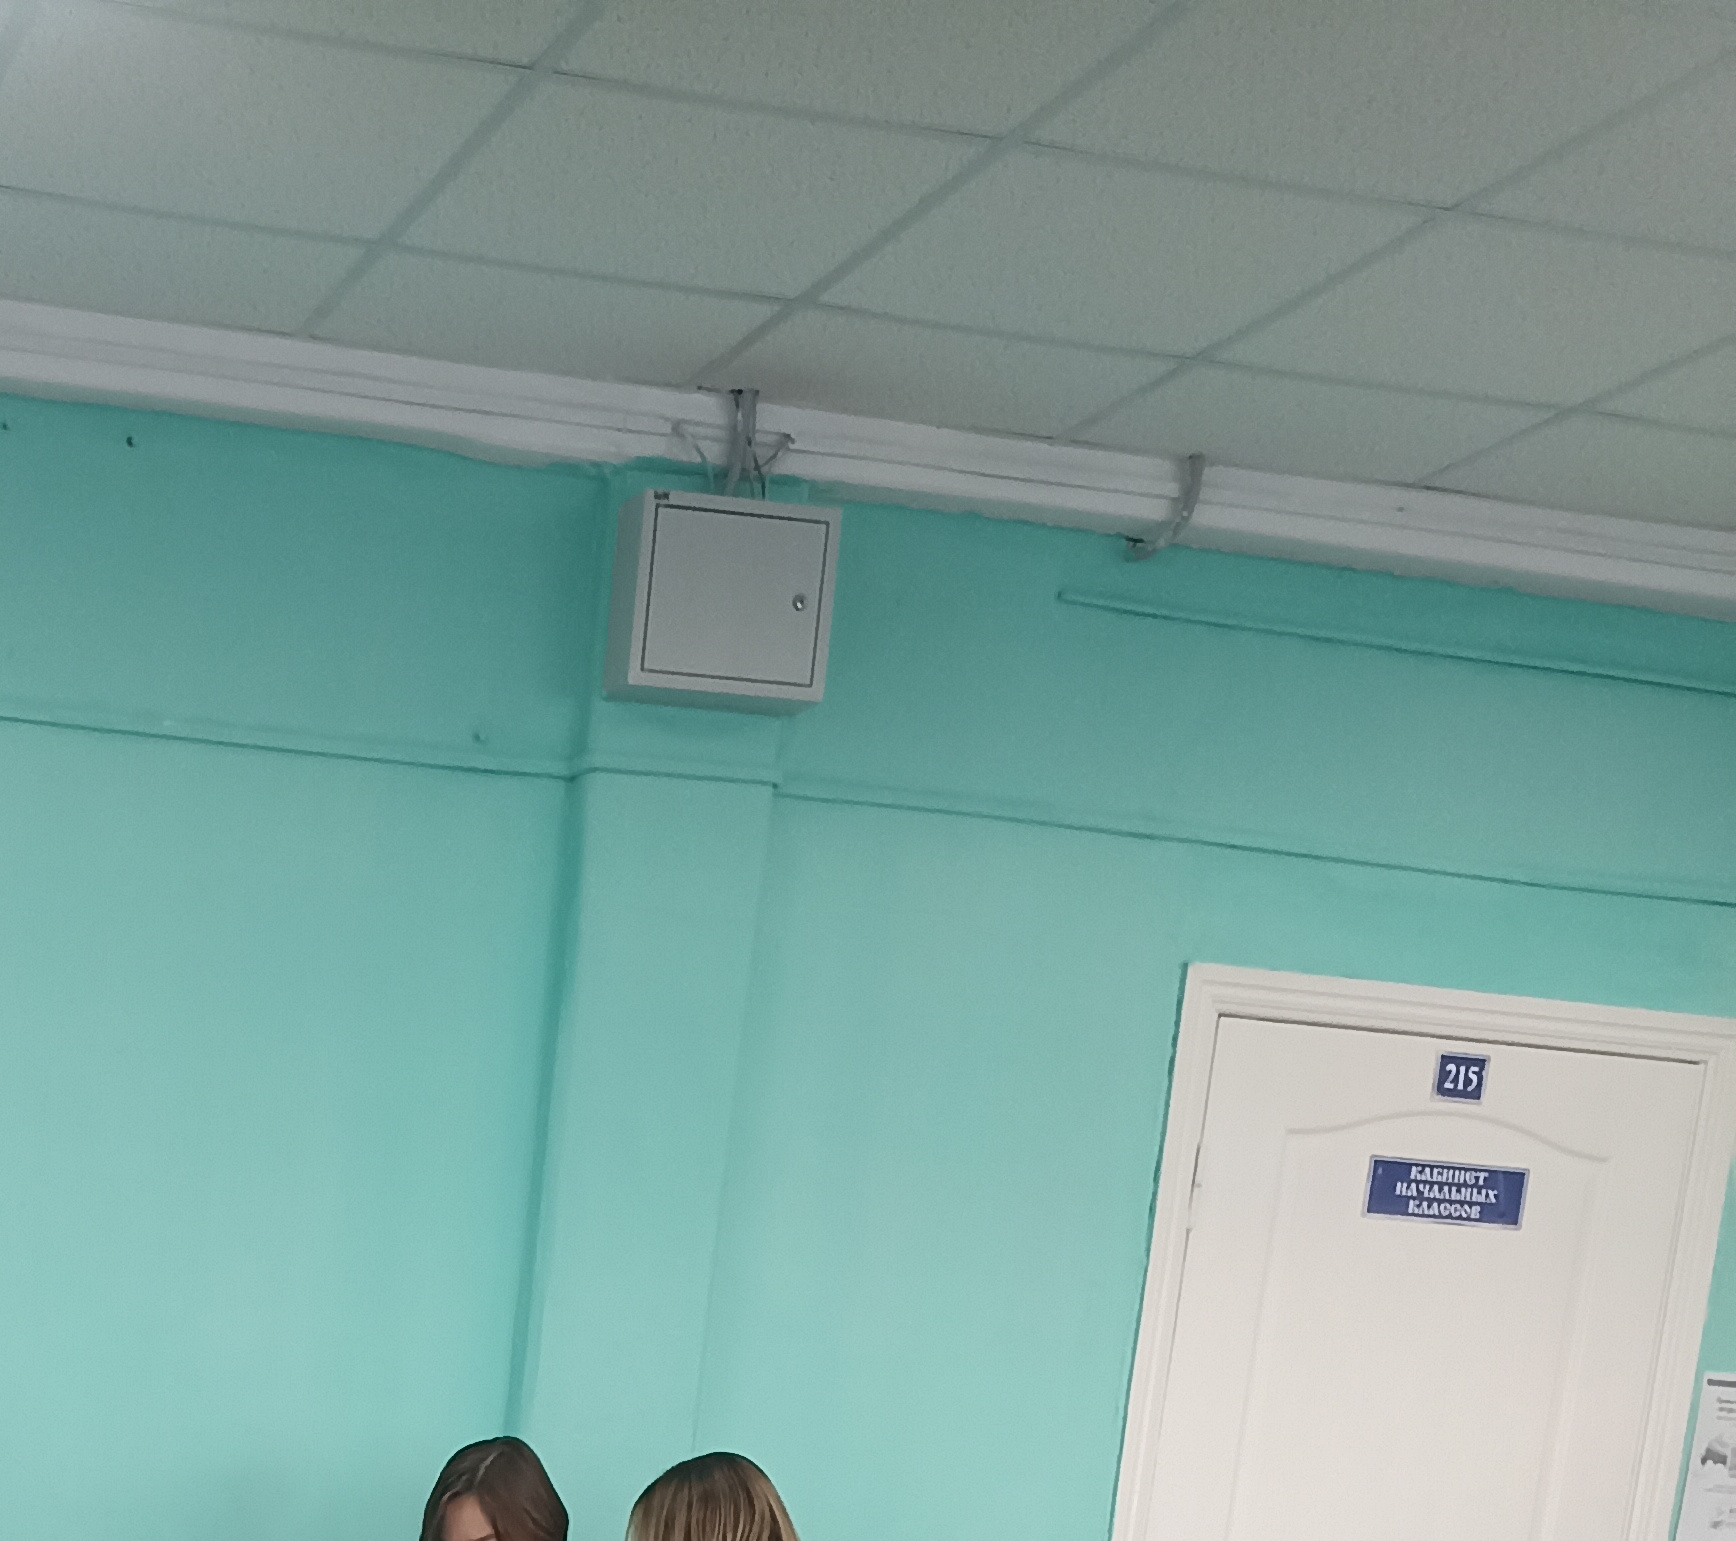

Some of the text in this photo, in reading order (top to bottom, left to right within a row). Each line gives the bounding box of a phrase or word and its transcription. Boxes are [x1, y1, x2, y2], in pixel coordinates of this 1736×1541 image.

[1444, 1063, 1480, 1092] 215
[1395, 1181, 1498, 1204] НАЧАЛЬНЫХ
[1408, 1199, 1481, 1219] КЛАССОВ
